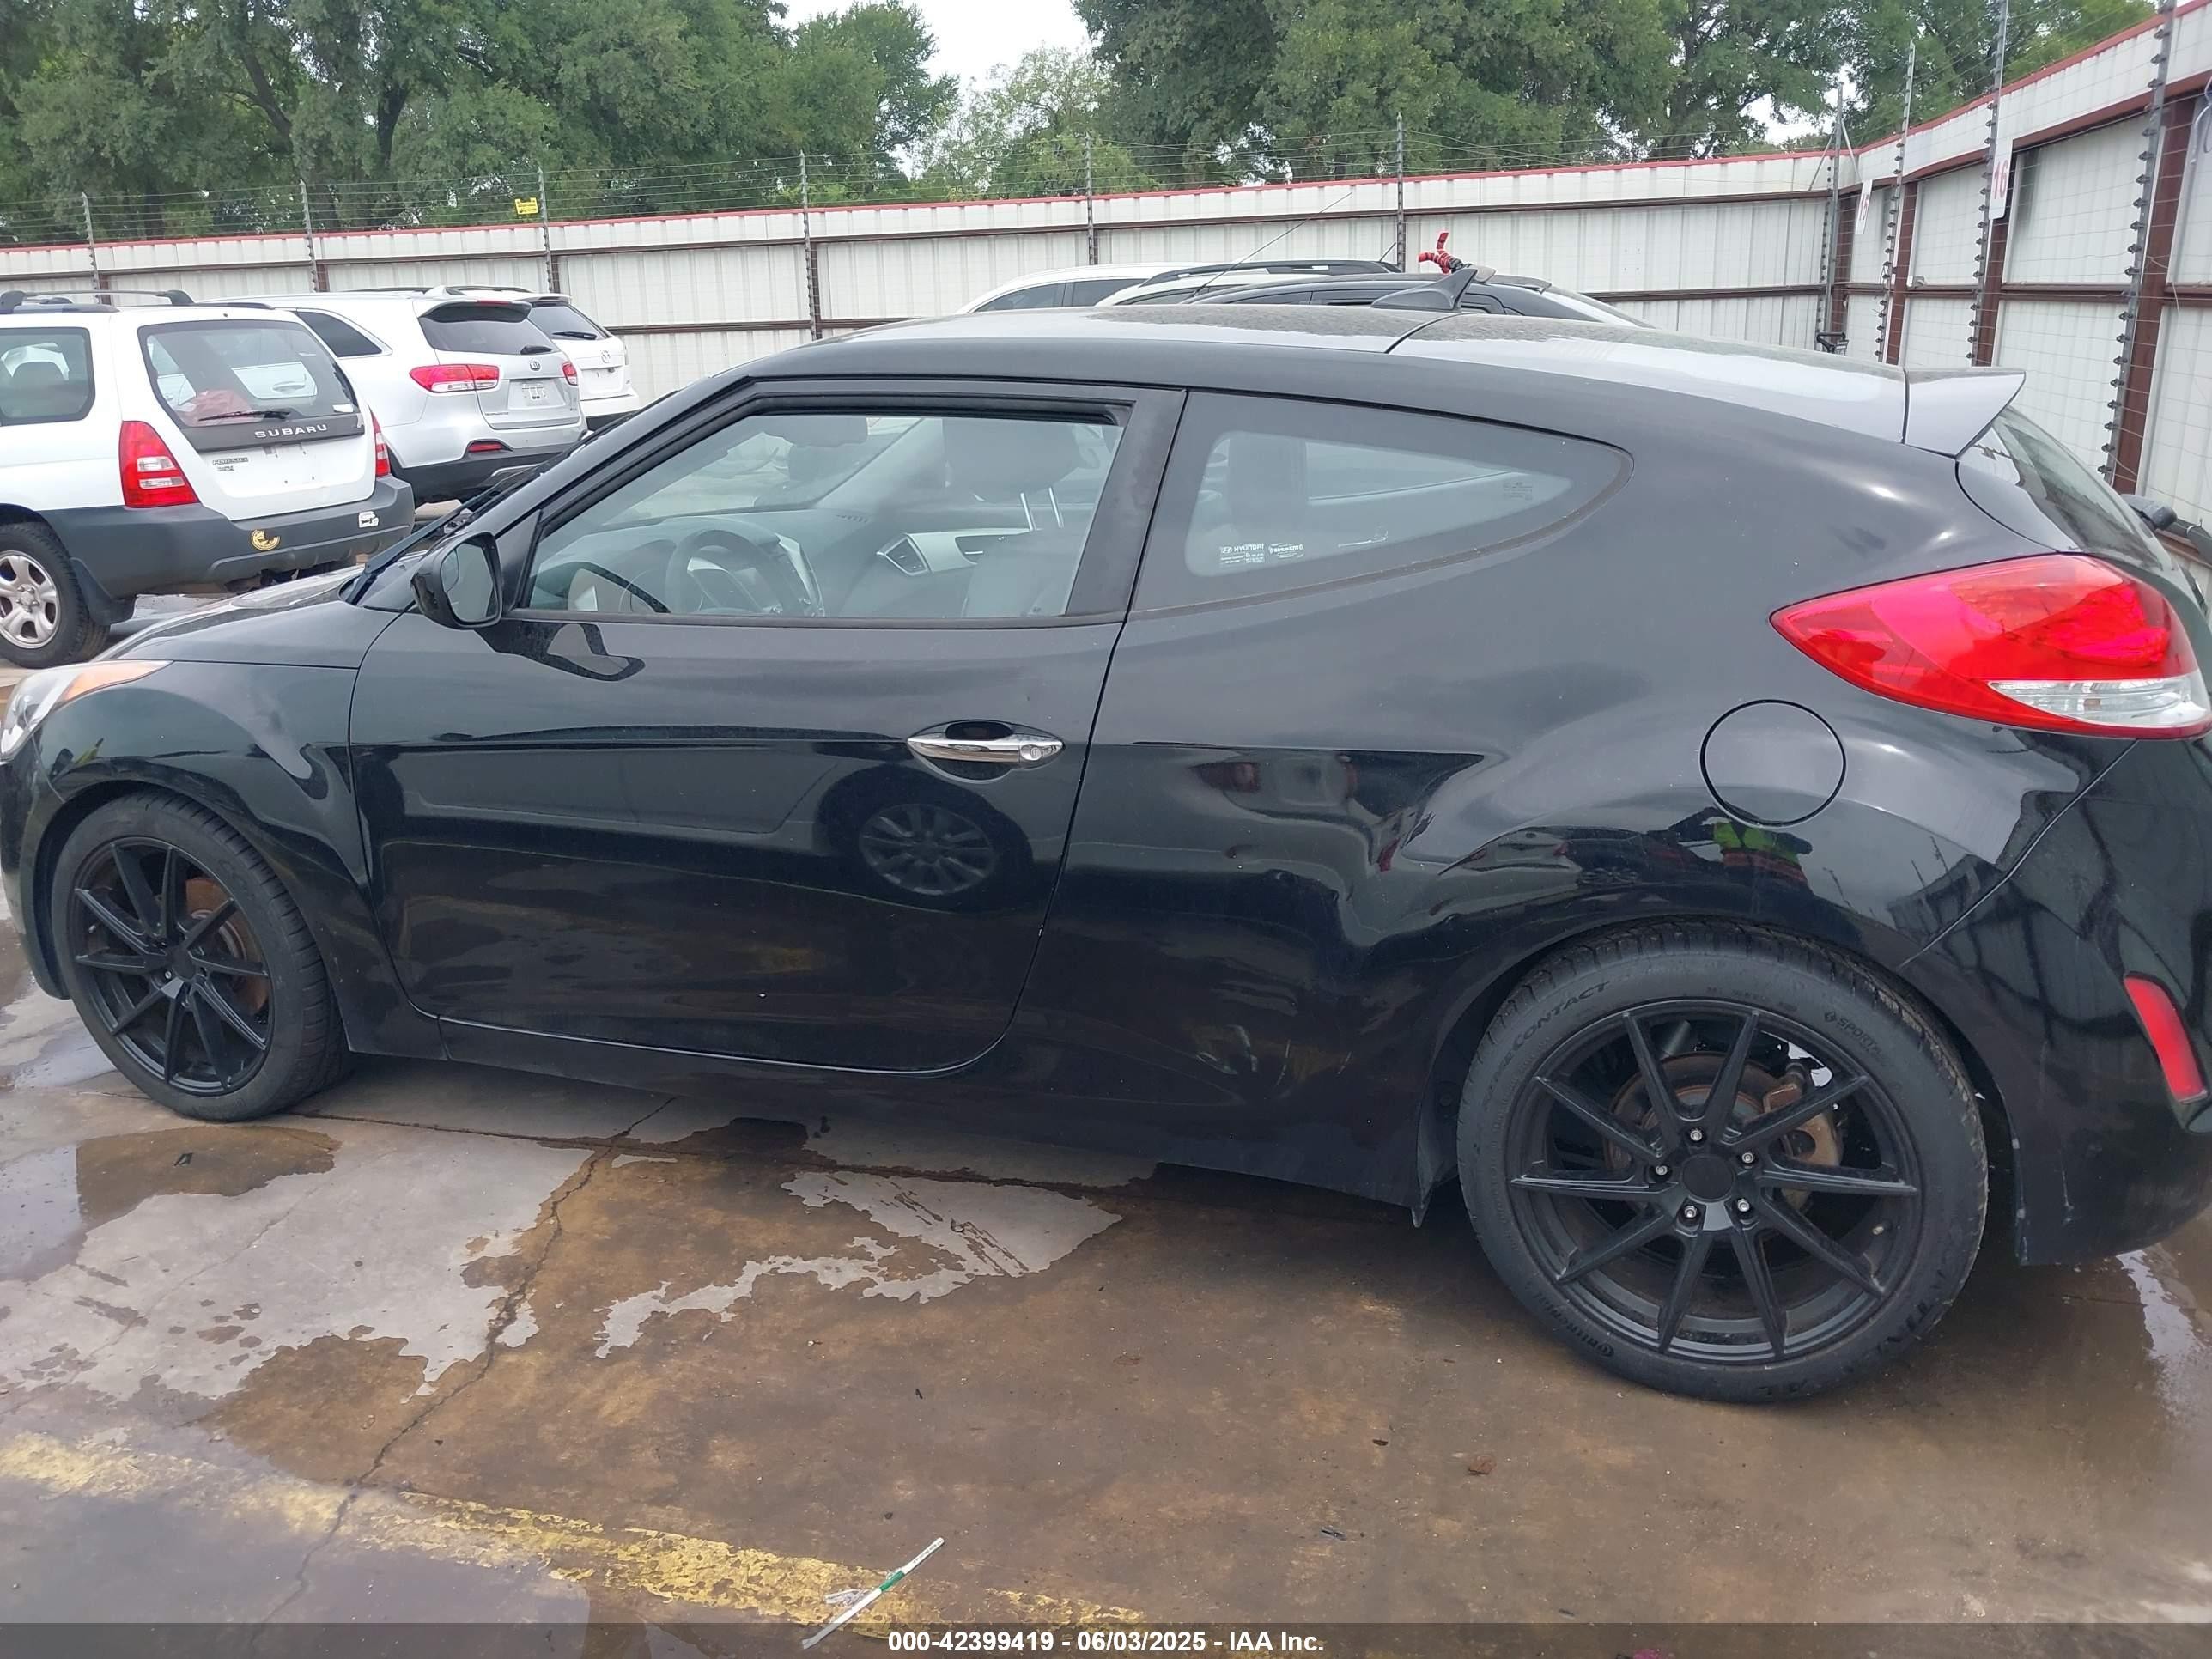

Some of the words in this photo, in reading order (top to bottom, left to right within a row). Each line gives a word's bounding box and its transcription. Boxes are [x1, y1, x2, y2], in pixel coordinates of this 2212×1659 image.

[1992, 160, 2009, 199] 16
[1858, 193, 1869, 221] 15
[254, 424, 328, 438] SUBARU
[1233, 543, 1265, 552] HYUNDAI
